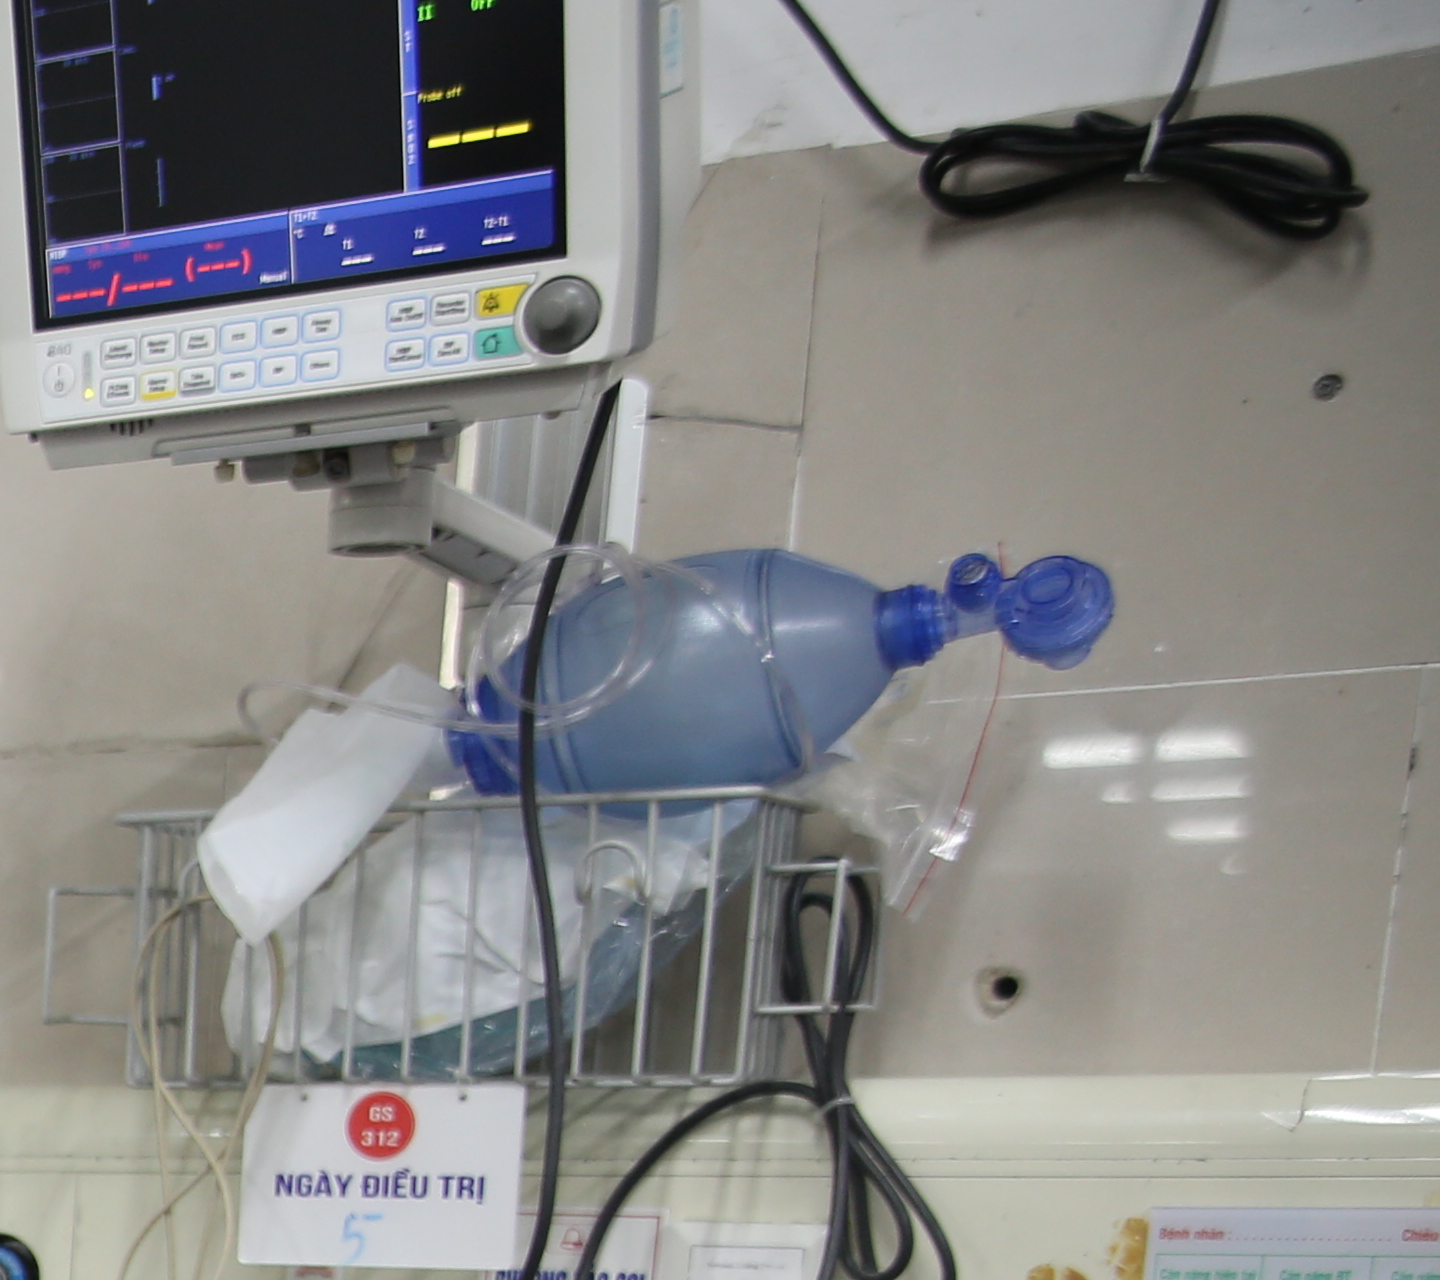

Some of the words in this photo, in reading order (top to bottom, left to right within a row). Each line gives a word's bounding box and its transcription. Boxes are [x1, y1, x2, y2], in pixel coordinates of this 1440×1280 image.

[369, 1106, 395, 1123] GS
[360, 1131, 400, 1148] 312
[274, 1170, 353, 1198] NGÀY
[361, 1168, 429, 1200] ĐIỀU
[438, 1175, 486, 1205] TRỊ
